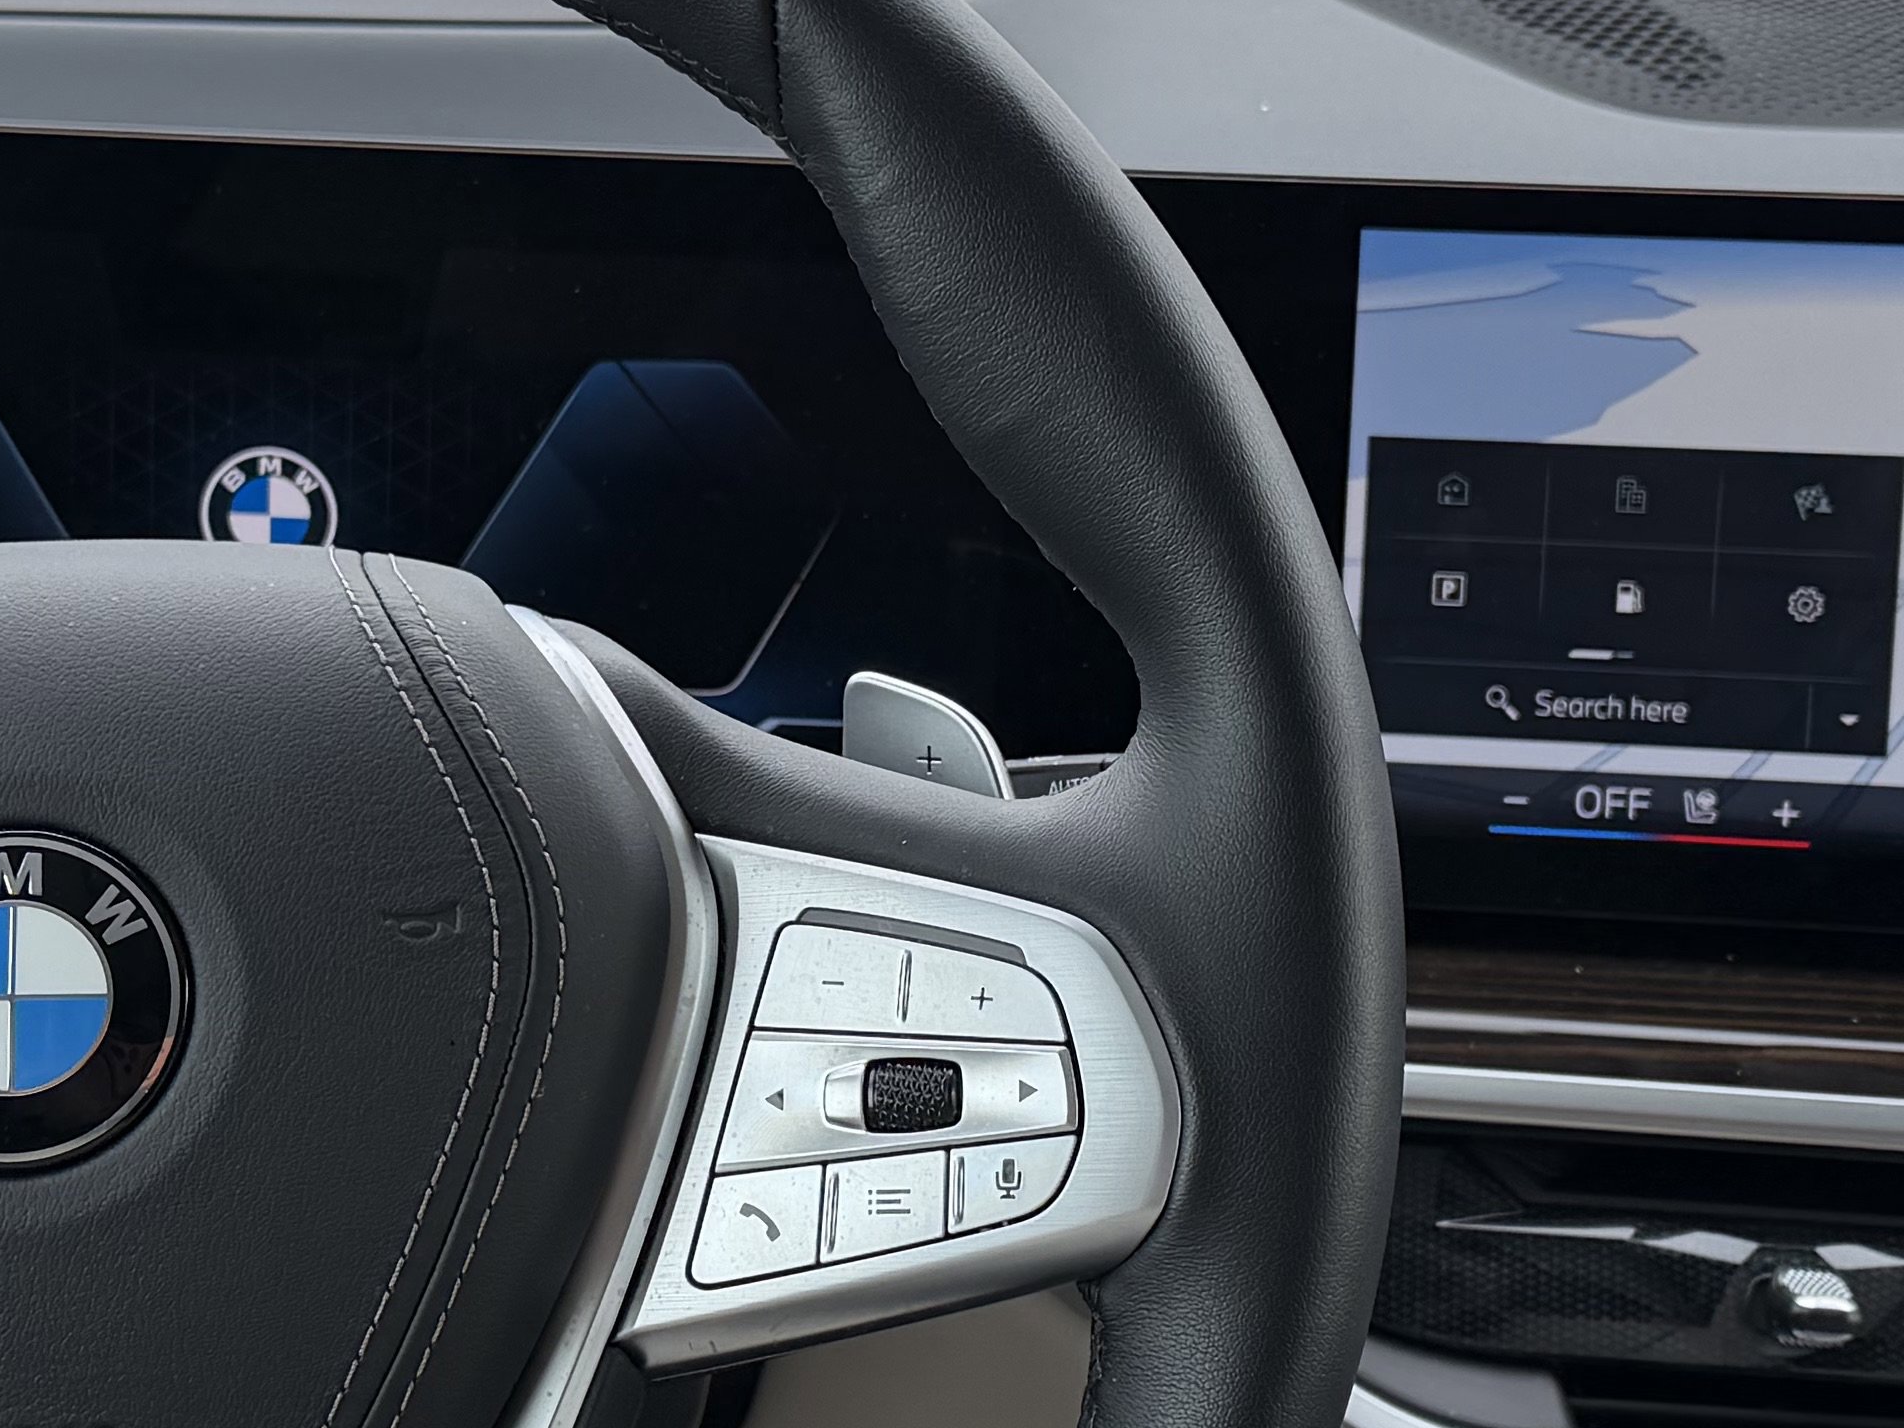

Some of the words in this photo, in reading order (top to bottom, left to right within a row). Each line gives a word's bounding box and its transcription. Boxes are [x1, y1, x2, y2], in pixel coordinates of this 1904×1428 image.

[220, 457, 321, 494] BMW
[1534, 688, 1624, 722] Search
[1630, 695, 1690, 724] here
[1575, 784, 1654, 821] OFF
